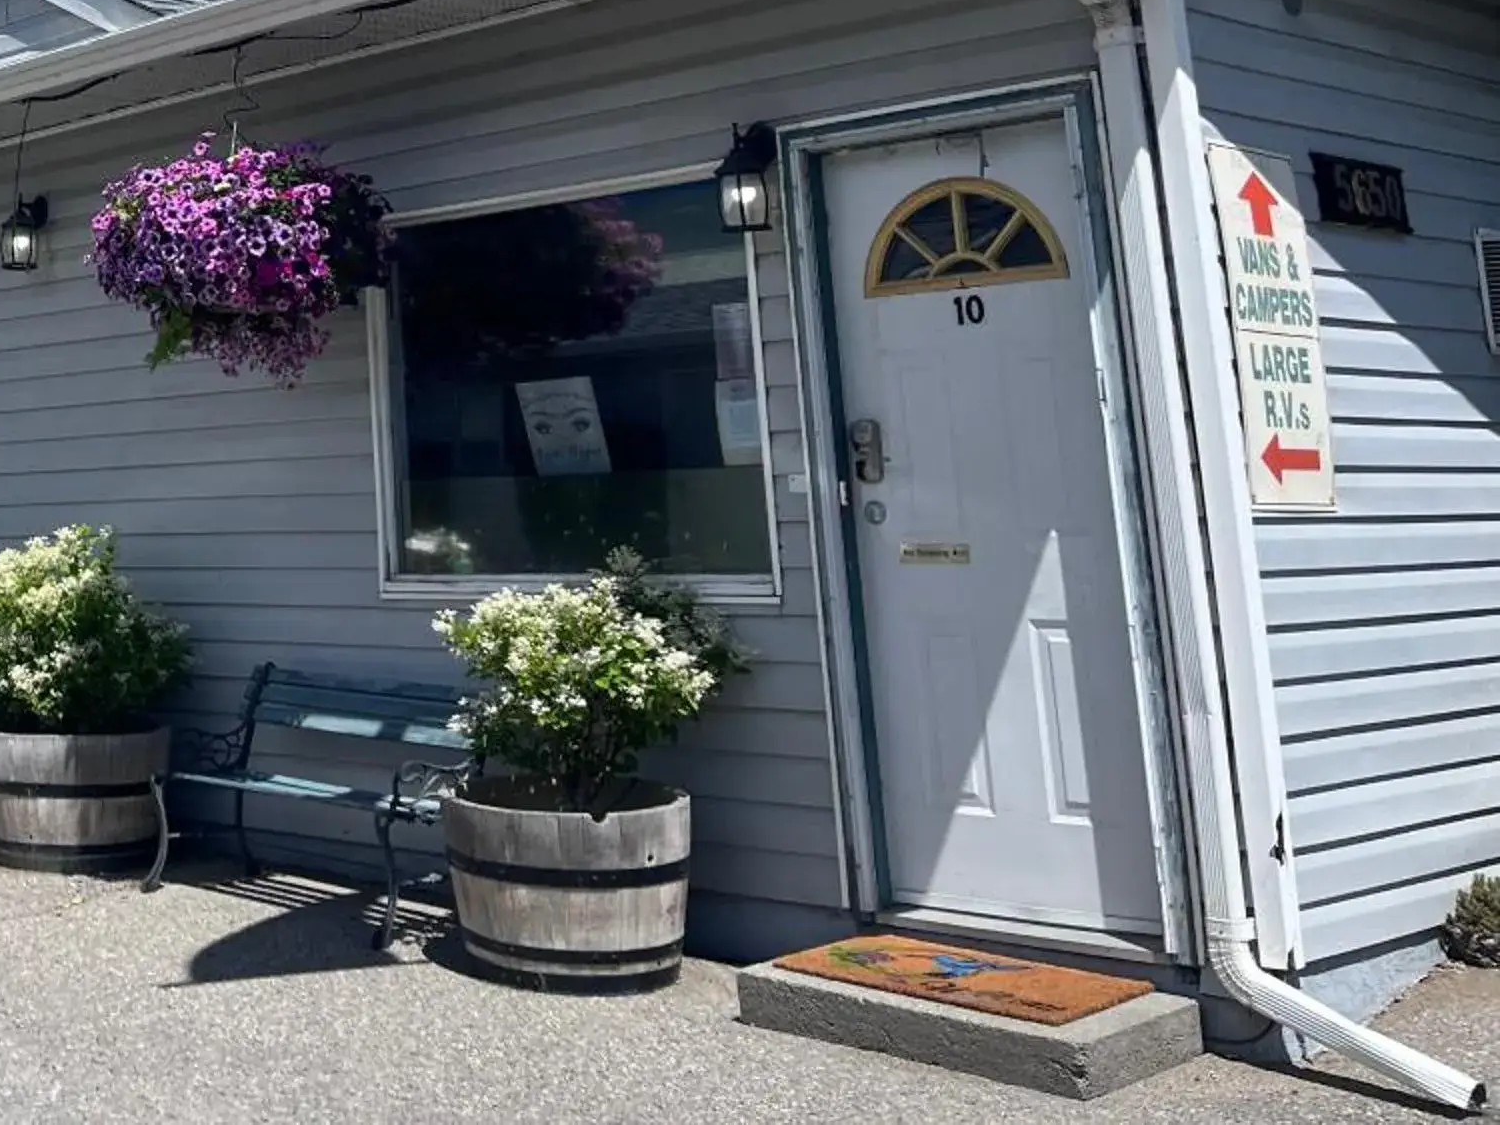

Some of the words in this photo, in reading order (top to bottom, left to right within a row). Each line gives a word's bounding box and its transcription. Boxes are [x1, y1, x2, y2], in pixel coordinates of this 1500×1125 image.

[1333, 164, 1401, 221] 5650
[1237, 236, 1281, 278] VANS
[1285, 244, 1300, 281] &
[953, 294, 985, 326] 10
[1235, 284, 1313, 328] CAMPERS
[1249, 342, 1312, 384] LARGE
